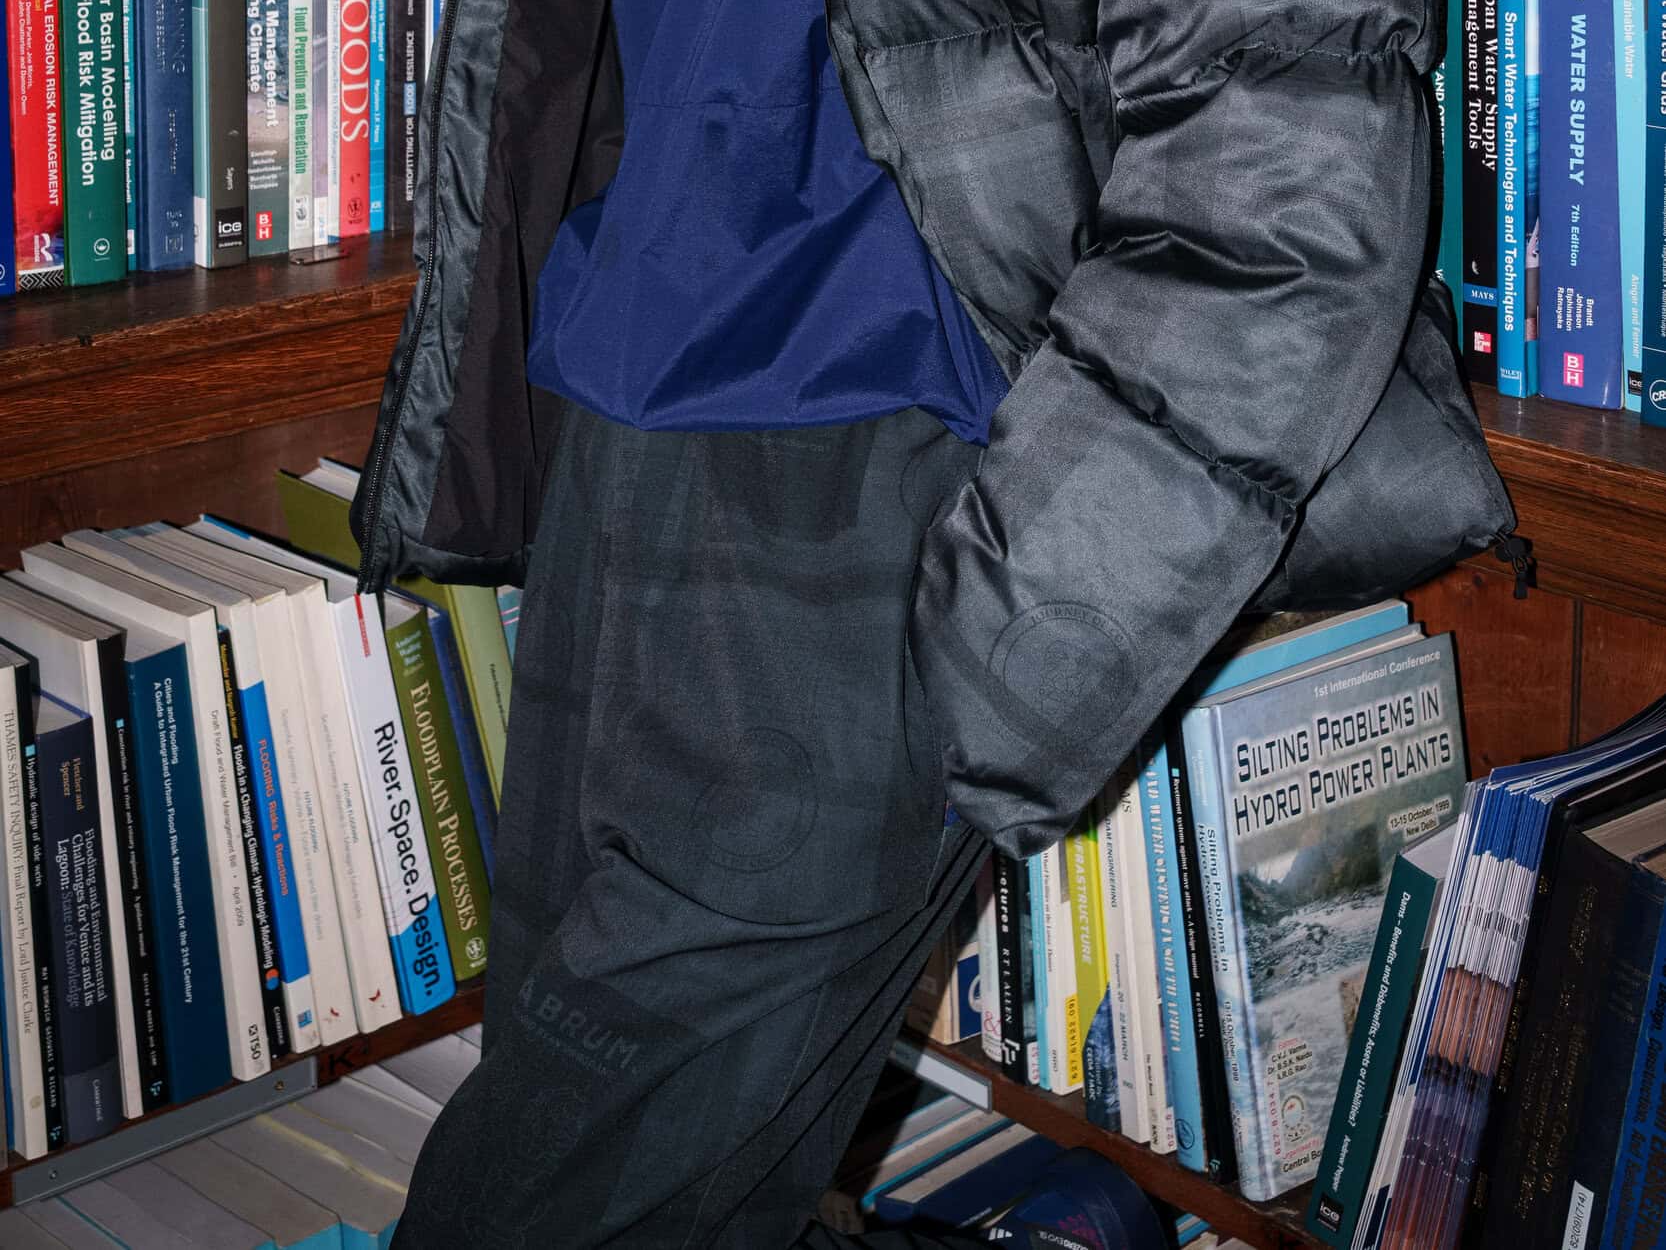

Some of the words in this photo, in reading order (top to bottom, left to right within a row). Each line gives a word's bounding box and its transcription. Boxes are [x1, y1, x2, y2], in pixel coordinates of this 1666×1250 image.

[44, 15, 55, 74] EROSION
[78, 51, 94, 86] Risk
[100, 12, 115, 60] Basin
[248, 21, 263, 93] Climate
[265, 9, 279, 127] Management
[1484, 38, 1498, 95] Water
[1504, 11, 1517, 59] Smart
[1569, 14, 1585, 91] WATER
[45, 78, 56, 109] RISK
[101, 67, 117, 161] Modelling
[1504, 61, 1517, 108] Water
[46, 112, 58, 206] MANAGEMENT
[79, 93, 97, 186] Mitigation
[1467, 98, 1481, 150] Tools
[1484, 102, 1498, 170] Supply
[1568, 99, 1585, 185] SUPPLY
[1503, 113, 1517, 211] Technologies
[1503, 215, 1517, 243] and
[1569, 226, 1580, 267] Edition
[1570, 204, 1580, 222] 7th
[1471, 291, 1494, 301] MAYS
[1503, 248, 1517, 331] Techniques
[1314, 683, 1328, 697] 1st
[1330, 665, 1387, 692] International
[1389, 651, 1441, 674] Conference
[374, 723, 403, 798] River.
[1237, 730, 1310, 782] SILTING
[1317, 697, 1413, 756] PROBLEMS
[1422, 689, 1439, 722] IN
[411, 683, 451, 817] FLOODPLAIN
[437, 819, 479, 931] PROCESSES
[1235, 785, 1301, 835] HYDRO
[1309, 759, 1373, 810] POWER
[1381, 733, 1451, 784] PLANTS
[386, 800, 422, 894] Space.
[404, 893, 445, 997] Design.
[249, 1038, 263, 1060] TSO
